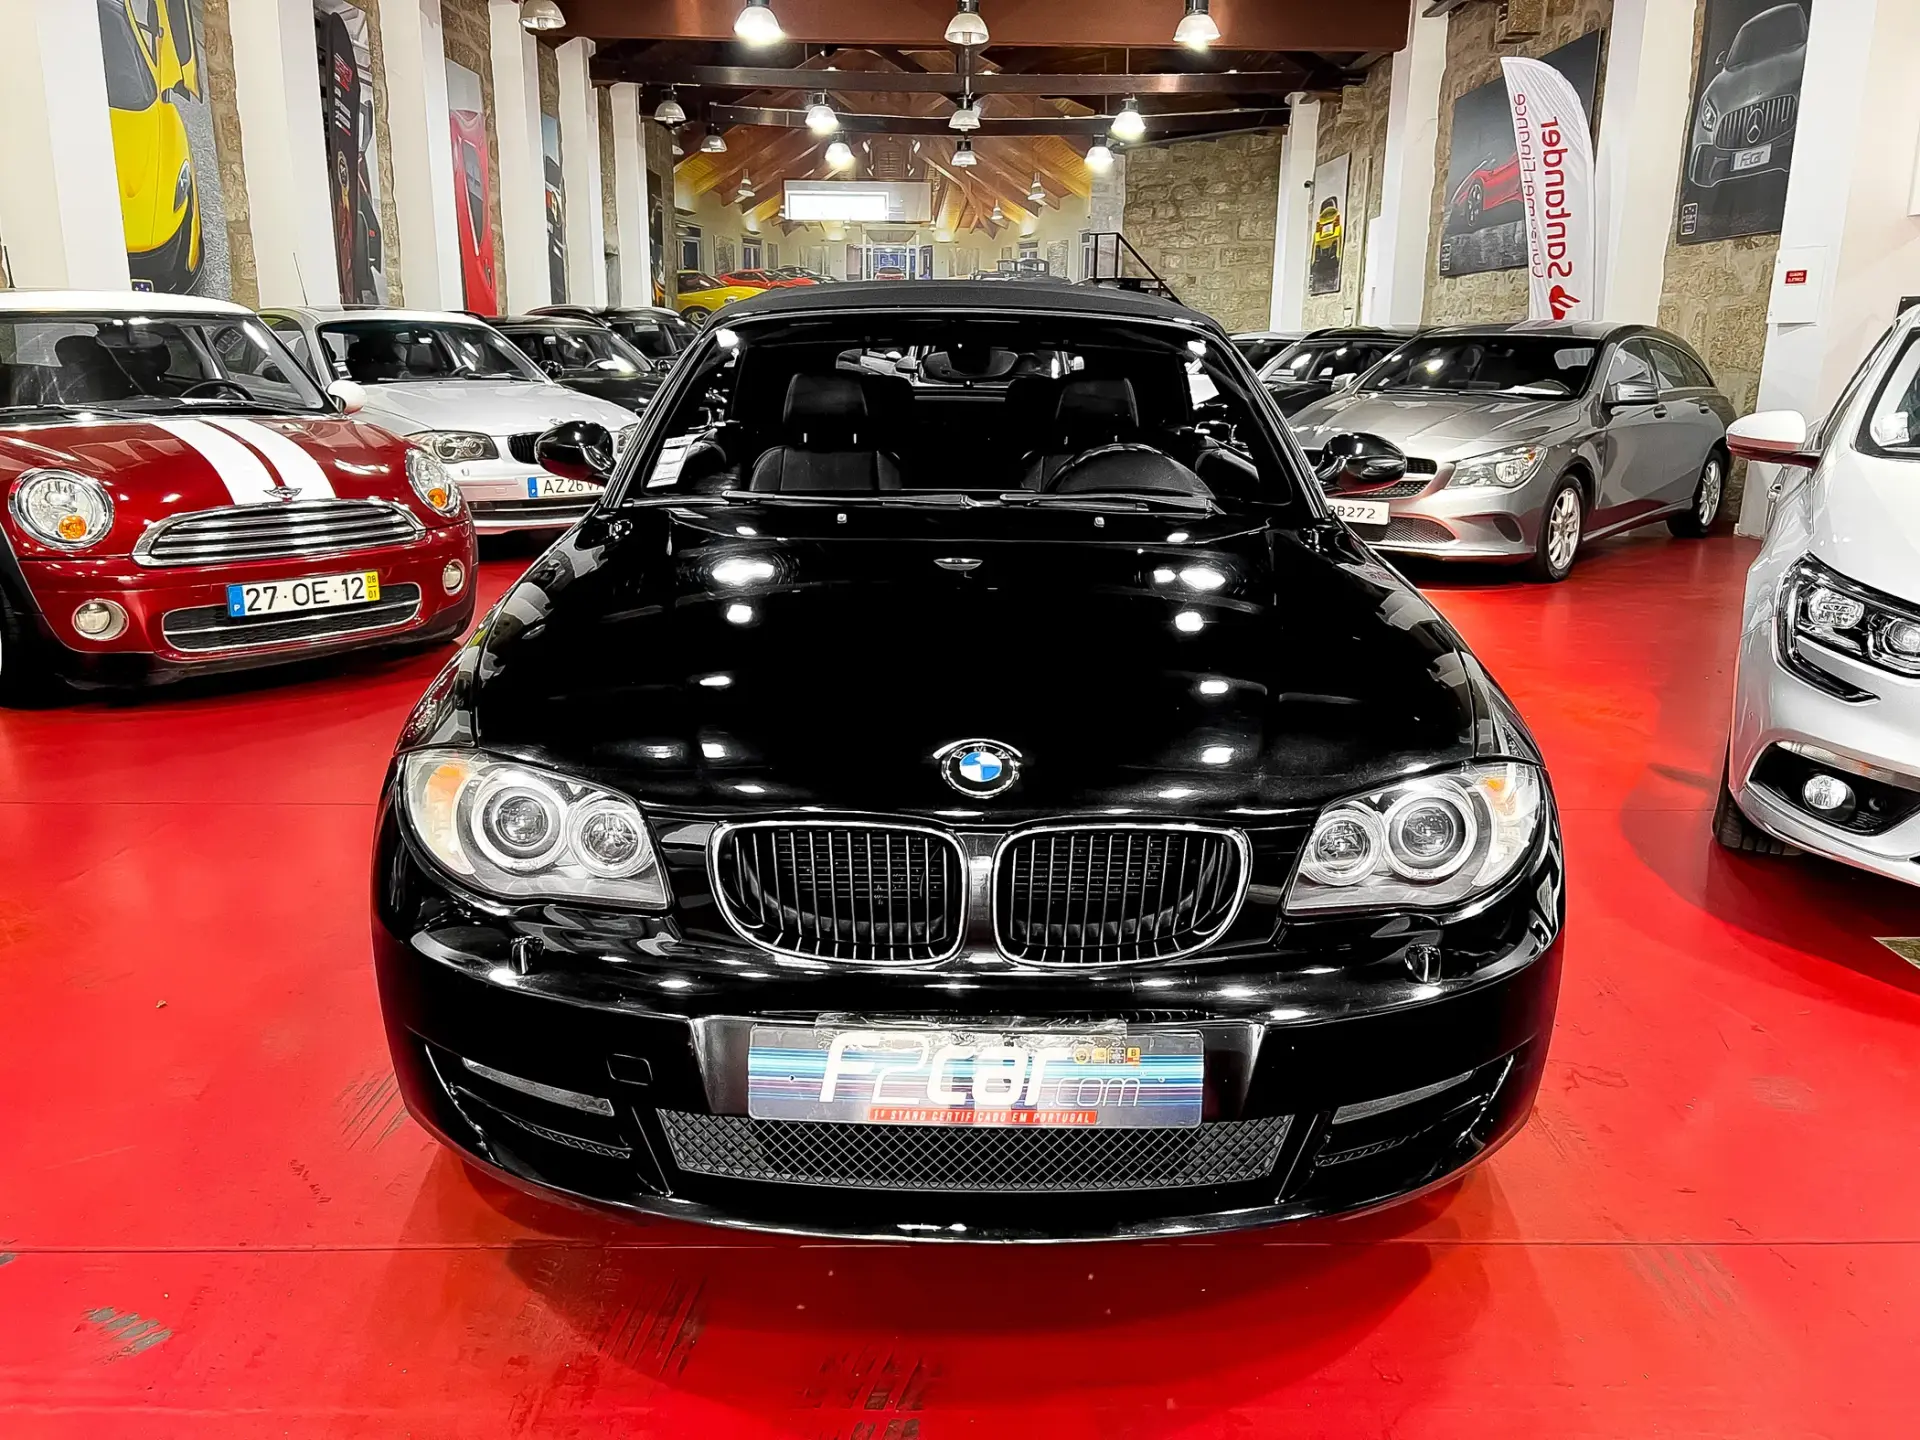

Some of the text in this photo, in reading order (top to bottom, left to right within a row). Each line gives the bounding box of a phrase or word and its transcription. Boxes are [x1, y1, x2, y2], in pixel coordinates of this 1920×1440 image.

[543, 478, 565, 494] AZ
[889, 1110, 927, 1121] STAND
[932, 1110, 1006, 1122] CERTIFICADO
[1012, 1112, 1028, 1122] EM
[1033, 1112, 1090, 1123] PORTUGAL
